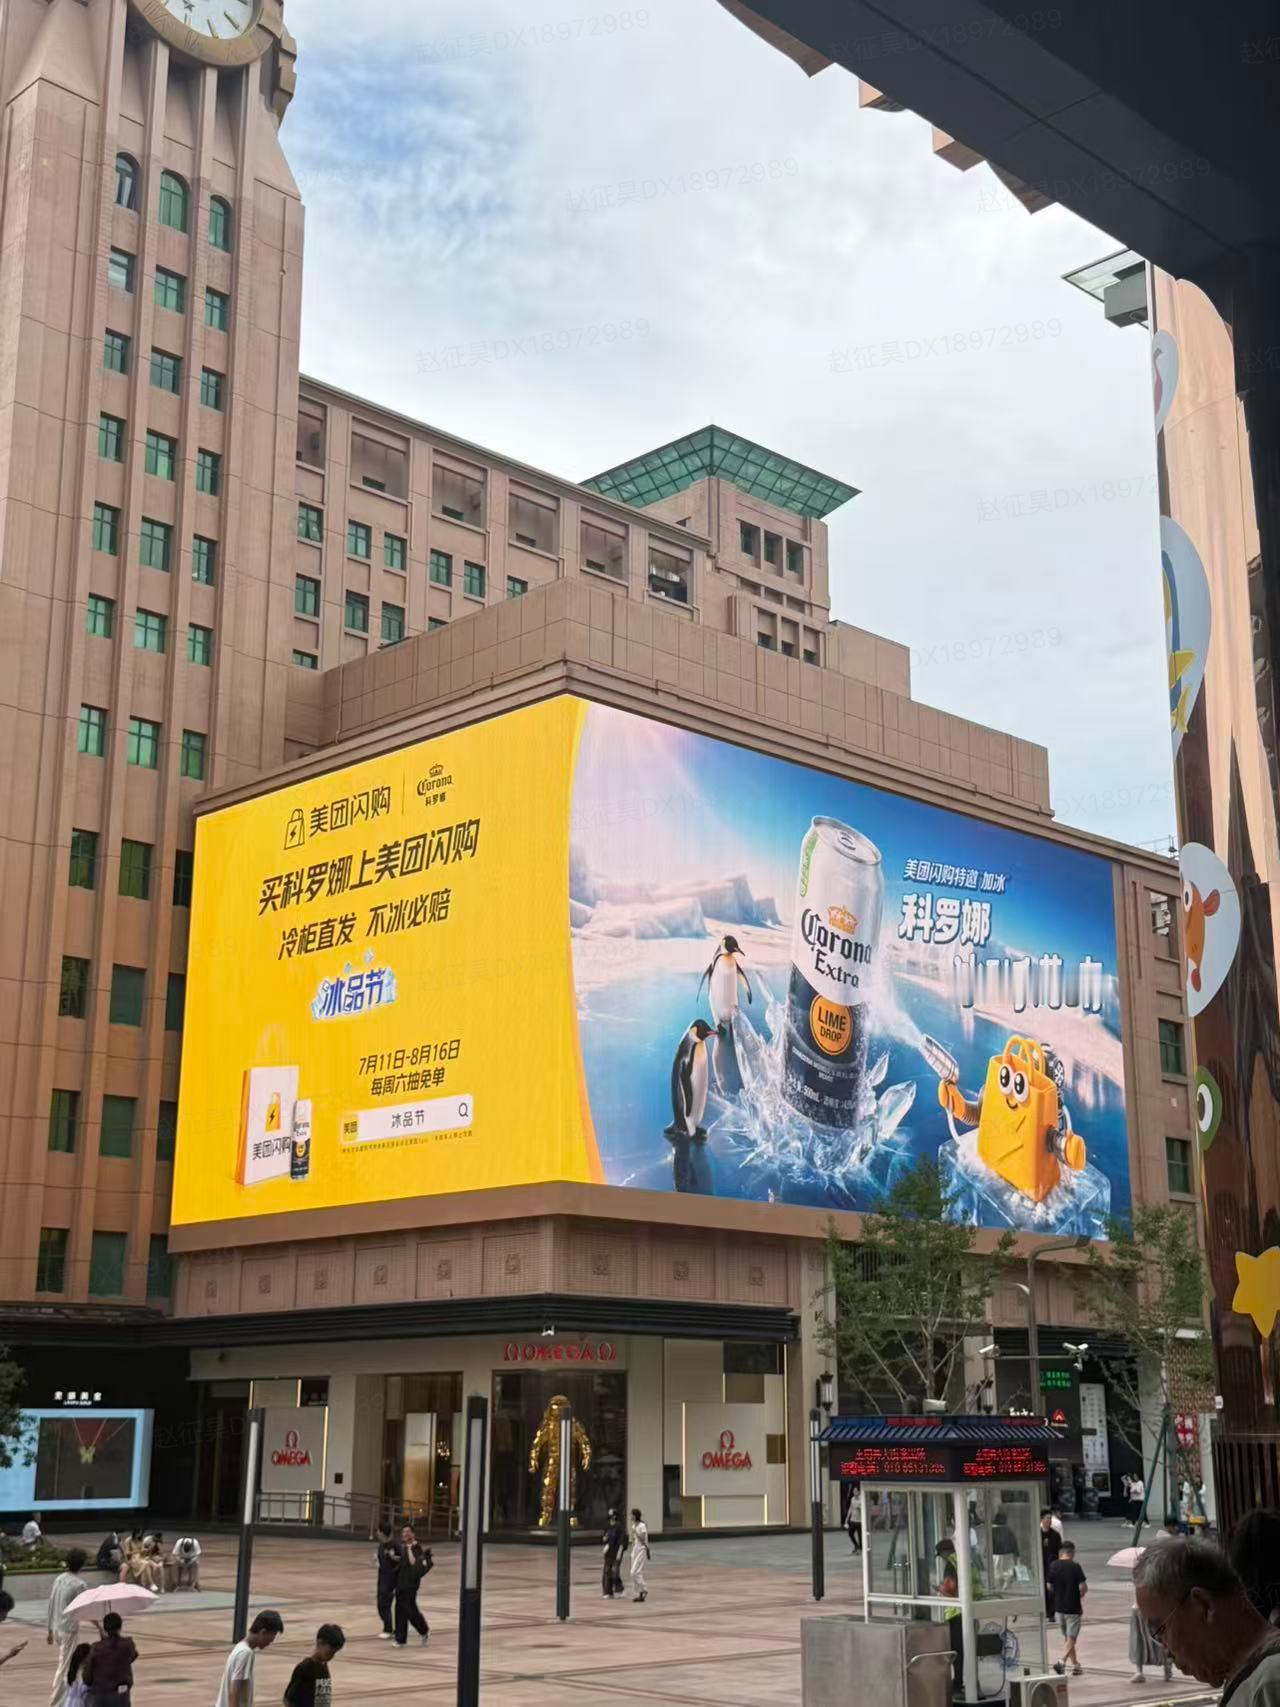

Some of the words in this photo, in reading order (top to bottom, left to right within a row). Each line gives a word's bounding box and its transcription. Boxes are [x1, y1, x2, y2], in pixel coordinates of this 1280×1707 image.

[416, 774, 453, 797] Corona
[309, 785, 391, 837] 美团闪购
[258, 818, 480, 916] 买科罗娜上美团闪购
[903, 858, 977, 889] 美团闪购特邀
[277, 912, 357, 960] 冷柜直发
[366, 888, 452, 937] 不冰必赔
[898, 892, 992, 946] 科罗娜
[801, 908, 871, 964] Corona
[814, 950, 859, 988] Extra
[317, 966, 387, 1017] 冰品节
[817, 1006, 846, 1031] LIME
[820, 1025, 842, 1043] DROP
[359, 1039, 460, 1075] 7月11日-8月16日
[371, 1067, 445, 1097] 每周六抽免单
[391, 1110, 424, 1128] 冰品节
[522, 1343, 595, 1361] OMEGA
[271, 1450, 312, 1466] OMEGA
[702, 1451, 752, 1471] OMEGA
